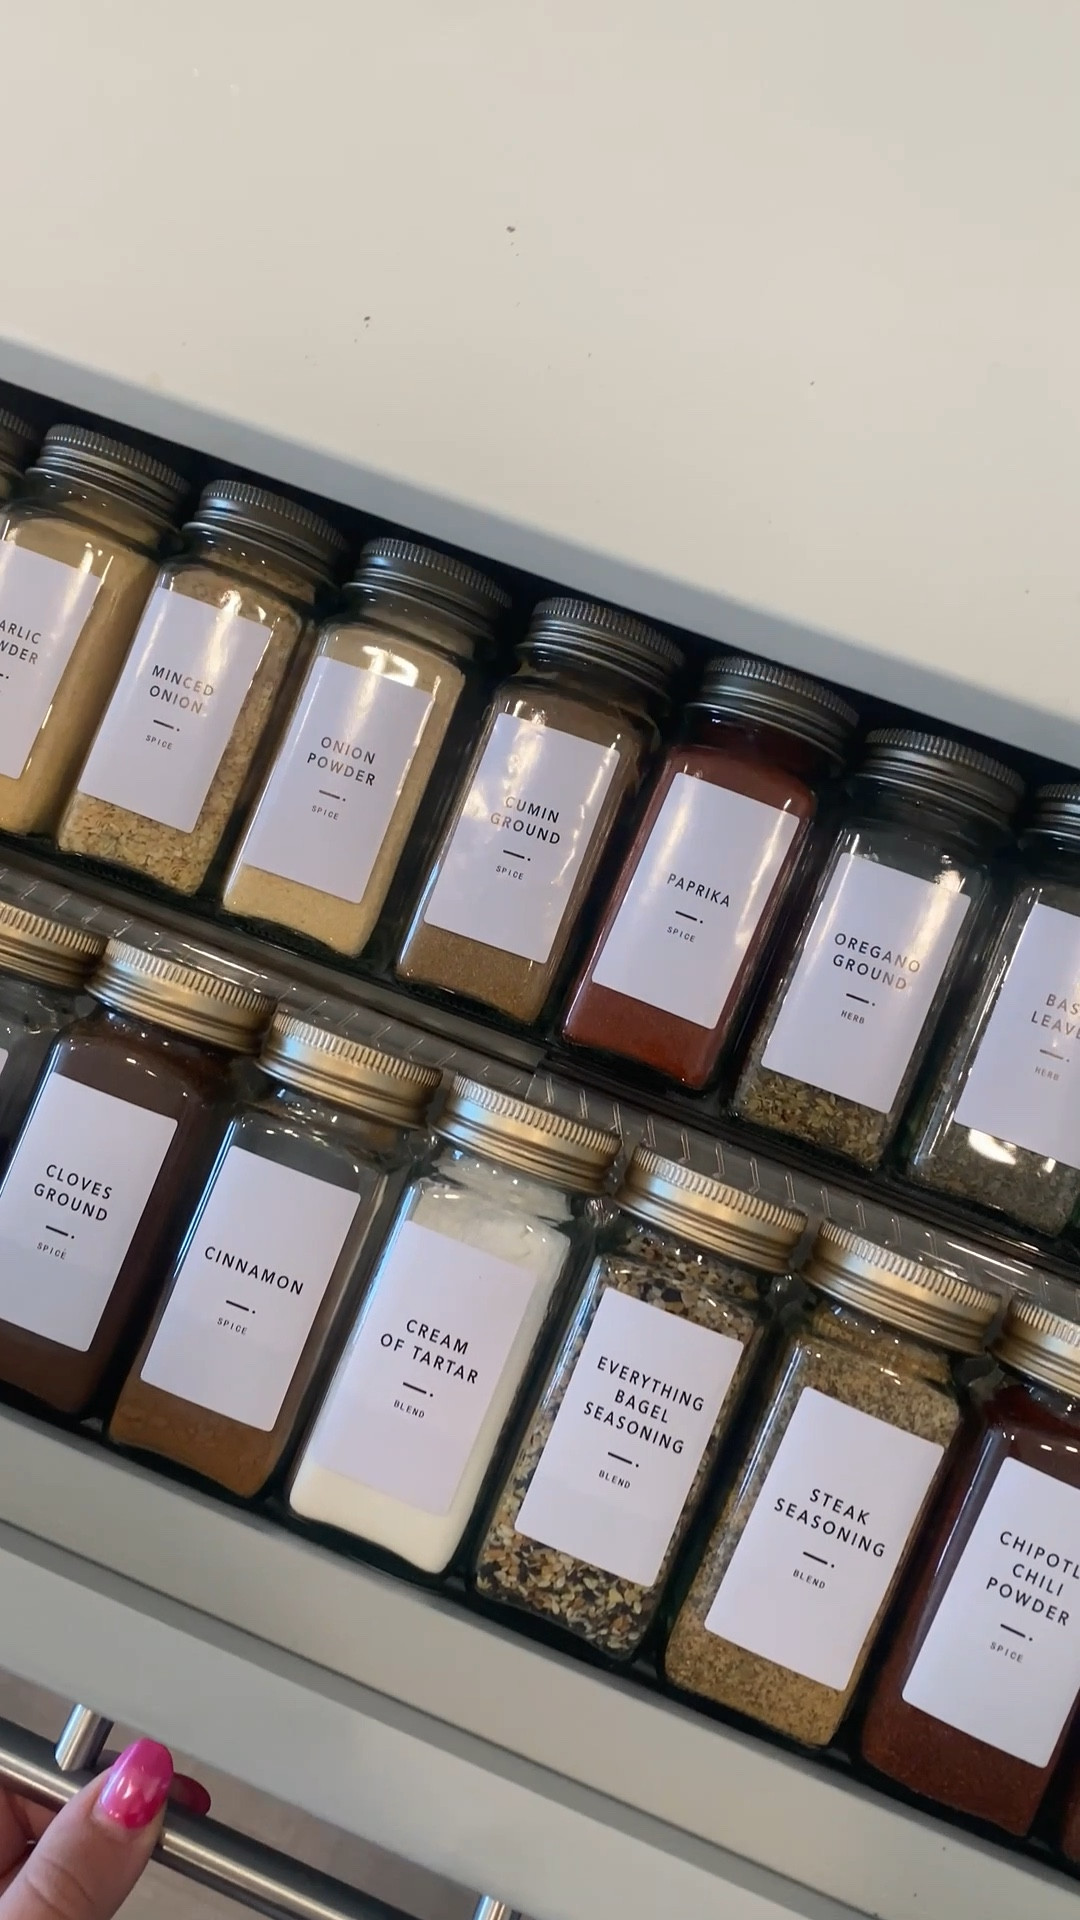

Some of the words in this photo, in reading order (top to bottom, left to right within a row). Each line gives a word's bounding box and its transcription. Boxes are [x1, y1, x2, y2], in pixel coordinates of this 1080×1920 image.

[152, 665, 214, 696] MINCED
[149, 685, 203, 714] ONION
[145, 735, 173, 750] SPICE
[321, 736, 376, 765] ONION
[306, 752, 376, 786] POWDER
[311, 805, 339, 820] SPICE
[505, 796, 560, 823] CUMIN
[490, 812, 560, 845] GROUND
[496, 865, 524, 880] SPICE
[667, 873, 730, 908] PAPRIKA
[667, 926, 696, 943] SPICE
[834, 932, 921, 973] OREGANO
[832, 954, 907, 990] GROUND
[840, 1010, 866, 1024] HERB
[1035, 1066, 1060, 1081] HERB
[46, 1164, 113, 1200] CLOVES
[33, 1183, 108, 1221] GROUND
[37, 1242, 66, 1260] SPICE
[204, 1246, 304, 1295] CINNAMON
[217, 1317, 248, 1336] SPICE
[406, 1319, 470, 1355] CREAM
[380, 1333, 405, 1352] OF
[412, 1346, 479, 1385] TARTAR
[597, 1357, 704, 1412] EVERYTHING
[393, 1400, 425, 1419] BLEND
[614, 1389, 668, 1424] BAGEL
[584, 1401, 685, 1455] SEASONING
[598, 1469, 631, 1489] BLEND
[809, 1488, 870, 1525] STEAK
[774, 1498, 885, 1557] SEASONING
[1000, 1531, 1080, 1579] CHIPOTL
[793, 1569, 826, 1589] BLEND
[1013, 1563, 1064, 1597] CHILI
[986, 1576, 1070, 1626] POWDER
[990, 1641, 1024, 1663] SPICE
